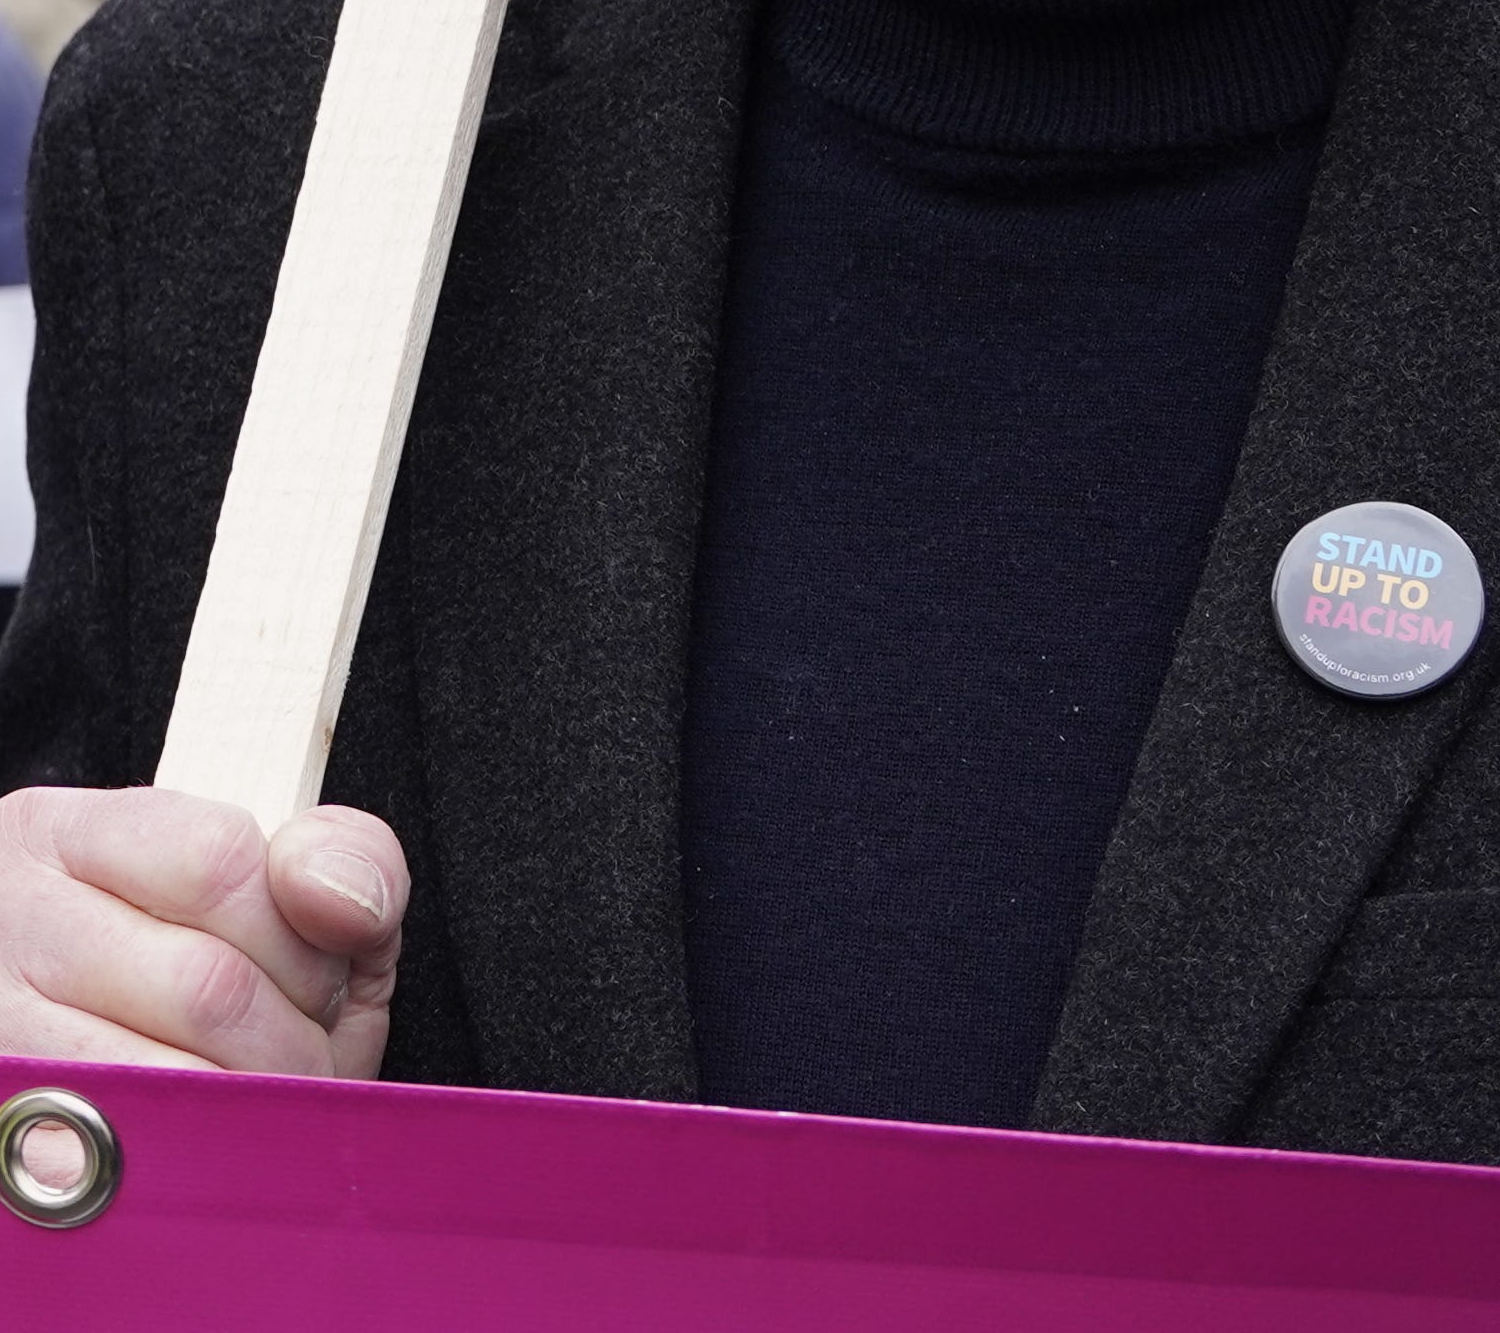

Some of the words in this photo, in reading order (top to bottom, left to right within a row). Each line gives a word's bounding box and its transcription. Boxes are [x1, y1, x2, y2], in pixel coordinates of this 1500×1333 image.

[1316, 532, 1443, 579] STAND
[1311, 562, 1366, 597] UP
[1377, 572, 1429, 610] TO
[1304, 595, 1454, 650] RACISM
